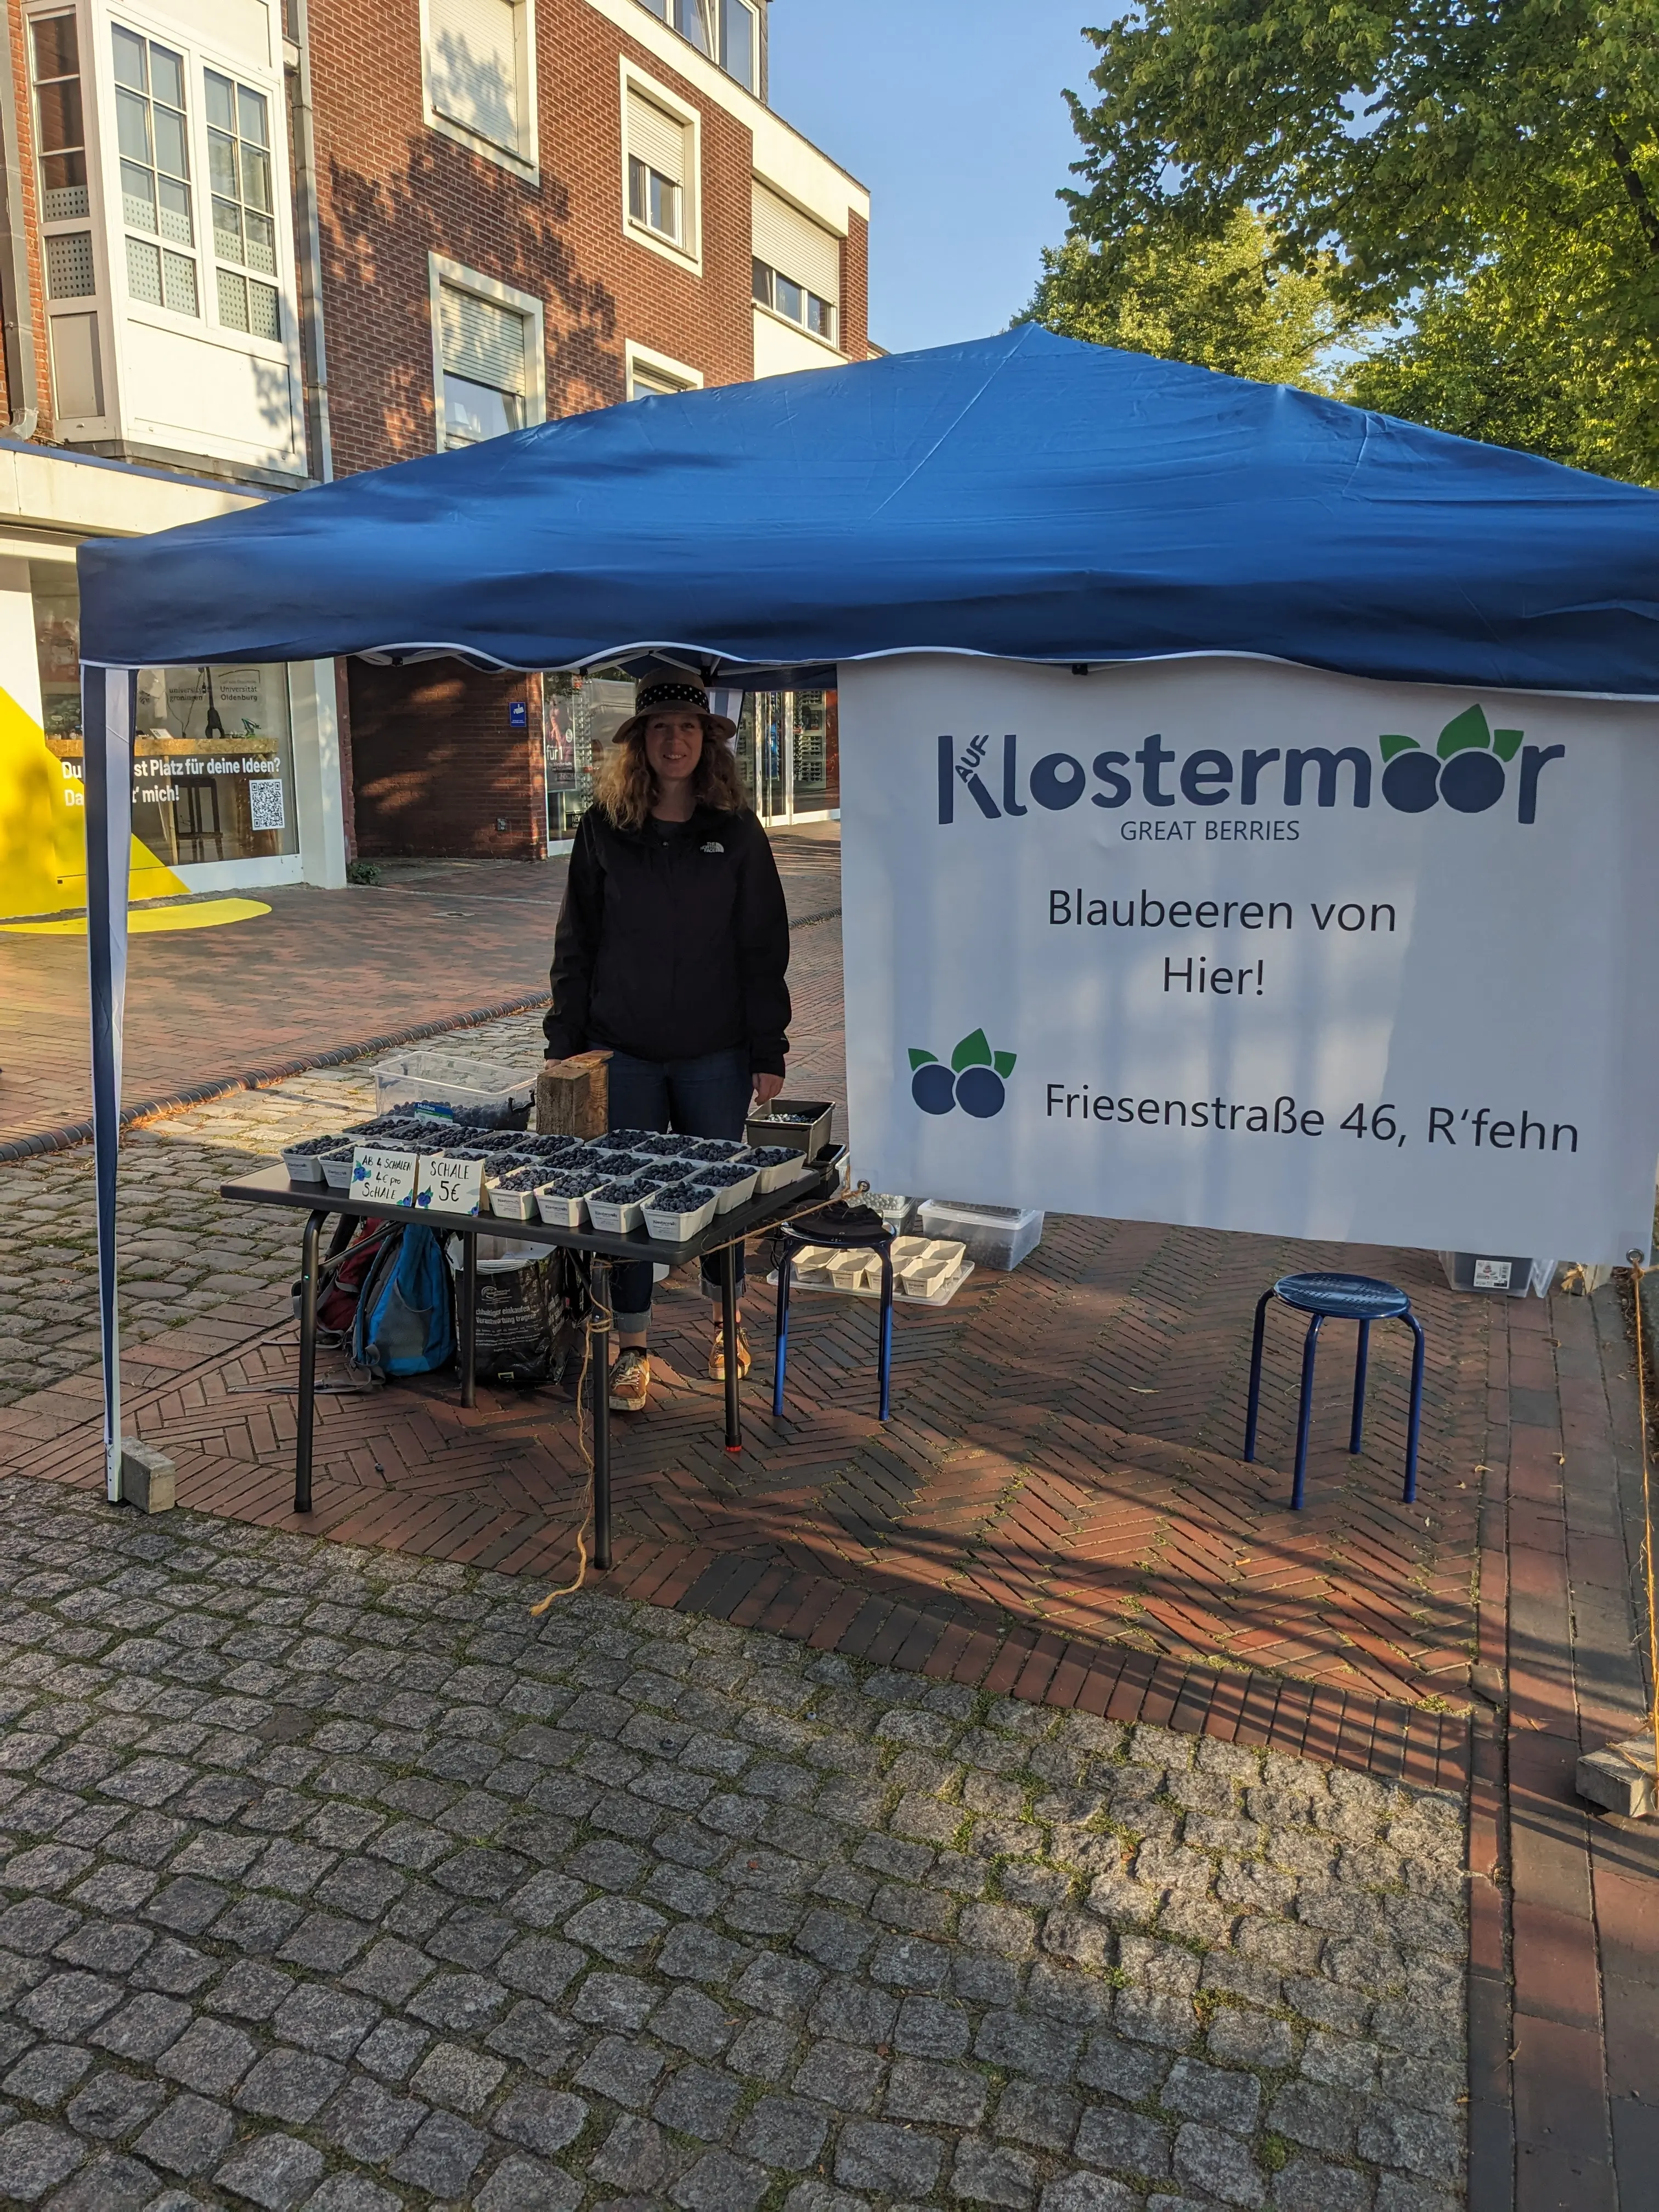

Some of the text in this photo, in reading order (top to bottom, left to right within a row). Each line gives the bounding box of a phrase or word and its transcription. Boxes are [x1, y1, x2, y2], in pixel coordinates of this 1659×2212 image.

[221, 694, 258, 702] Oldenburg
[61, 761, 82, 779] Du
[150, 759, 184, 776] Platz
[185, 758, 204, 775] für
[207, 758, 240, 774] deine
[242, 757, 281, 773] Ideen?
[938, 734, 1565, 825] Klostermoor
[142, 785, 179, 803] mich!
[1121, 820, 1299, 840] GREAT BERRIES
[1049, 888, 1395, 932] Blaubeeren von
[1164, 956, 1263, 996] Hier!
[417, 1103, 435, 1111] Multibox
[1047, 1084, 1324, 1136] Friesenstraße
[1340, 1103, 1406, 1148] 46,
[362, 1155, 412, 1171] AB 4 SCHALEN
[430, 1161, 470, 1180] SCHALE
[390, 1177, 401, 1186] pro
[439, 1181, 461, 1202] 5€
[502, 1305, 531, 1315] einkaufen
